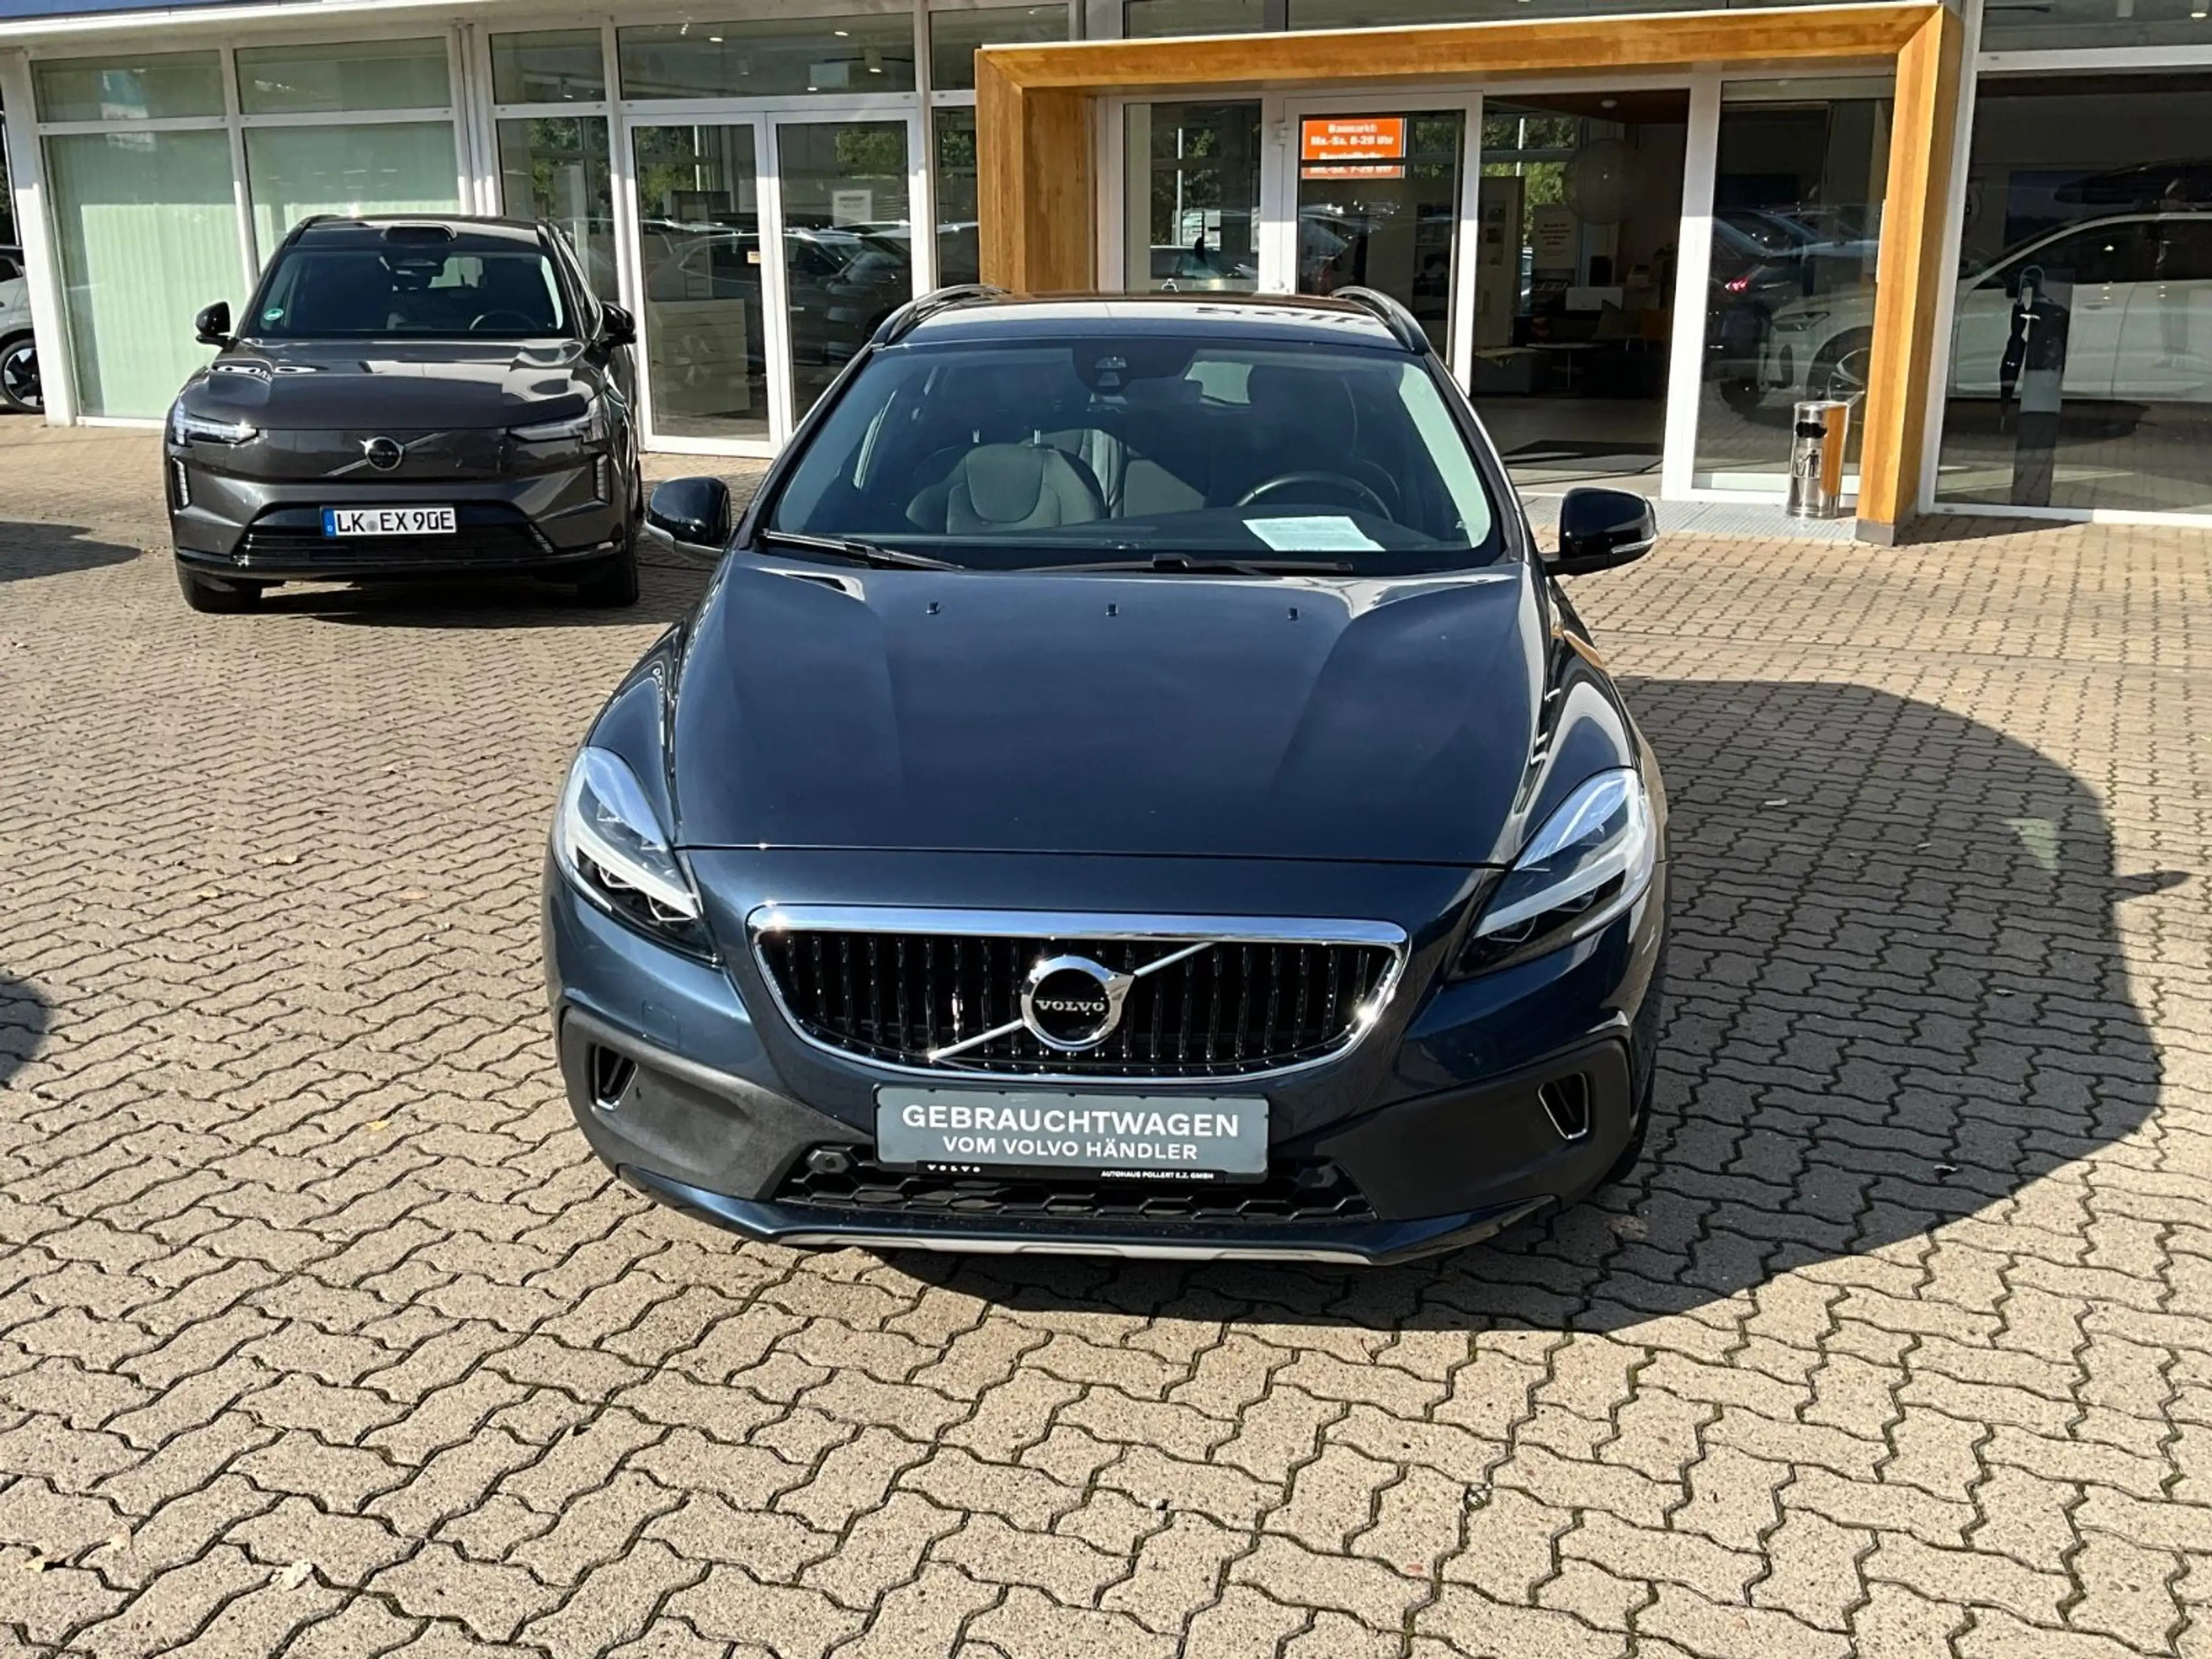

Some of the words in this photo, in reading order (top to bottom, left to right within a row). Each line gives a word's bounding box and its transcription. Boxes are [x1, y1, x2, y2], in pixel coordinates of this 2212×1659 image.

[337, 513, 365, 532] LK
[380, 512, 408, 532] EX
[1036, 999, 1105, 1012] VOLVO
[902, 1104, 1238, 1137] GEBRAUCHTWAGEN
[942, 1135, 996, 1154] VOM
[1002, 1139, 1079, 1157] VOLVO
[1086, 1138, 1198, 1160] HÄNDLER
[927, 1164, 980, 1173] VOLVO
